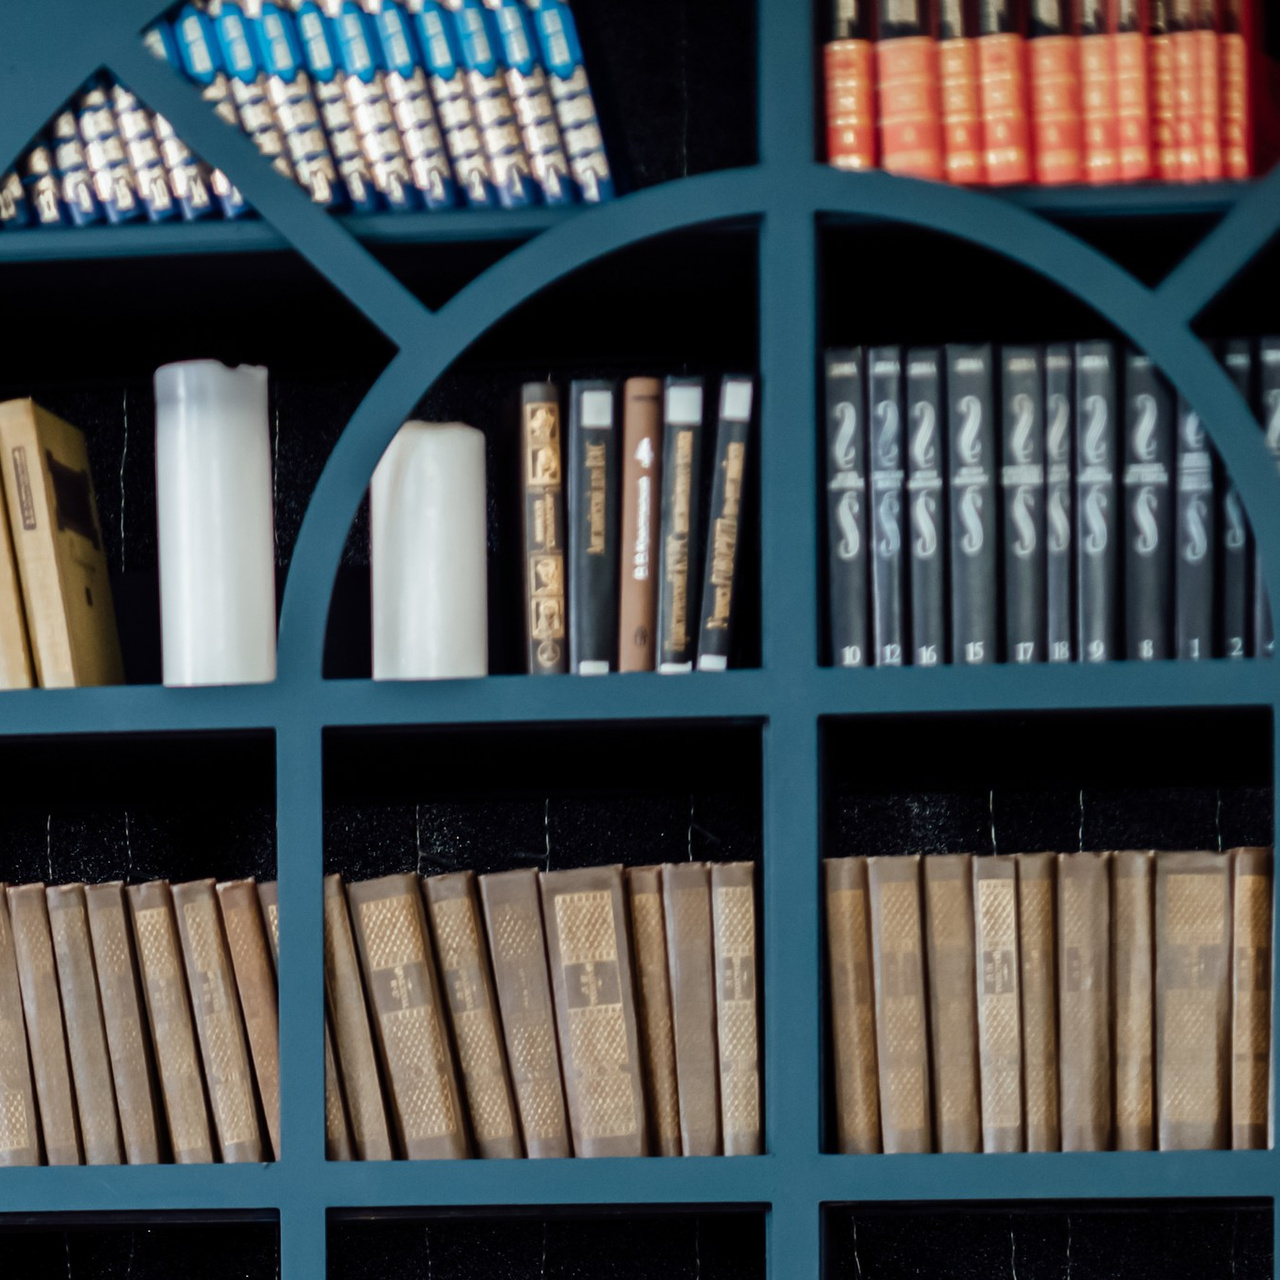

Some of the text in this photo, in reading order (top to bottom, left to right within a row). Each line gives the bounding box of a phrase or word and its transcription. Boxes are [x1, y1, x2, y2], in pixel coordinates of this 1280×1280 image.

[842, 645, 861, 665] 10
[883, 644, 901, 664] 12
[919, 645, 937, 664] 16
[966, 641, 984, 661] 15
[1016, 642, 1034, 661] 17
[1053, 641, 1069, 660] 18
[1089, 640, 1104, 660] 9
[1141, 639, 1153, 659] 8
[1192, 638, 1199, 657] 1
[1230, 637, 1243, 656] 2
